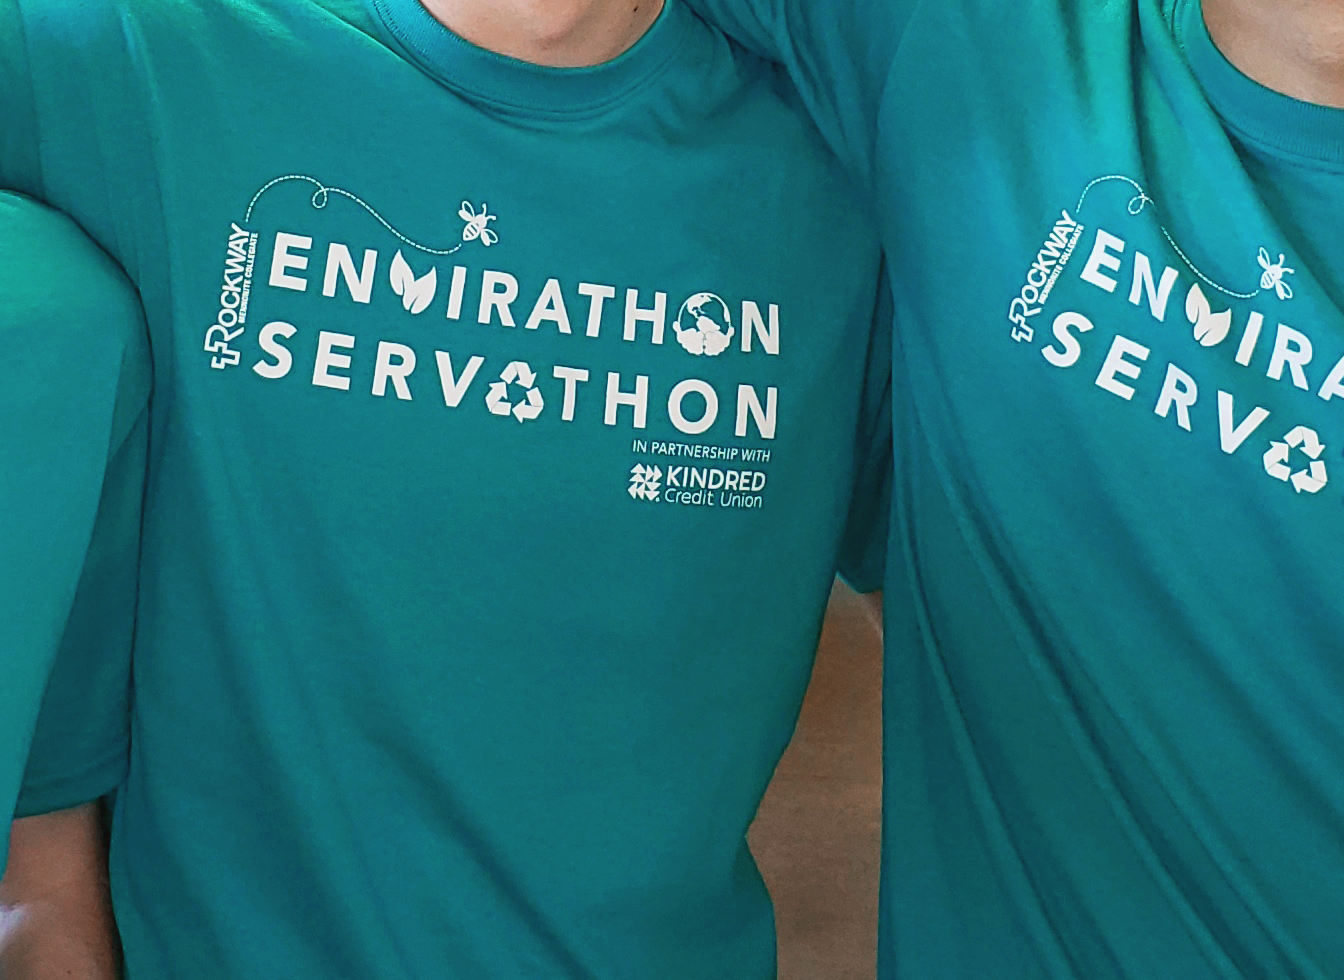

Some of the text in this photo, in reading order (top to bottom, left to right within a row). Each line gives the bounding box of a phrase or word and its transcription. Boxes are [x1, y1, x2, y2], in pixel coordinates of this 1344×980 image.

[1008, 209, 1077, 324] ROCKWAY
[204, 222, 250, 352] ROCKWAY
[632, 439, 772, 463] IN PARTNERSHIP WITH
[666, 465, 766, 492] KINDRED
[664, 487, 763, 509] Credit Union
